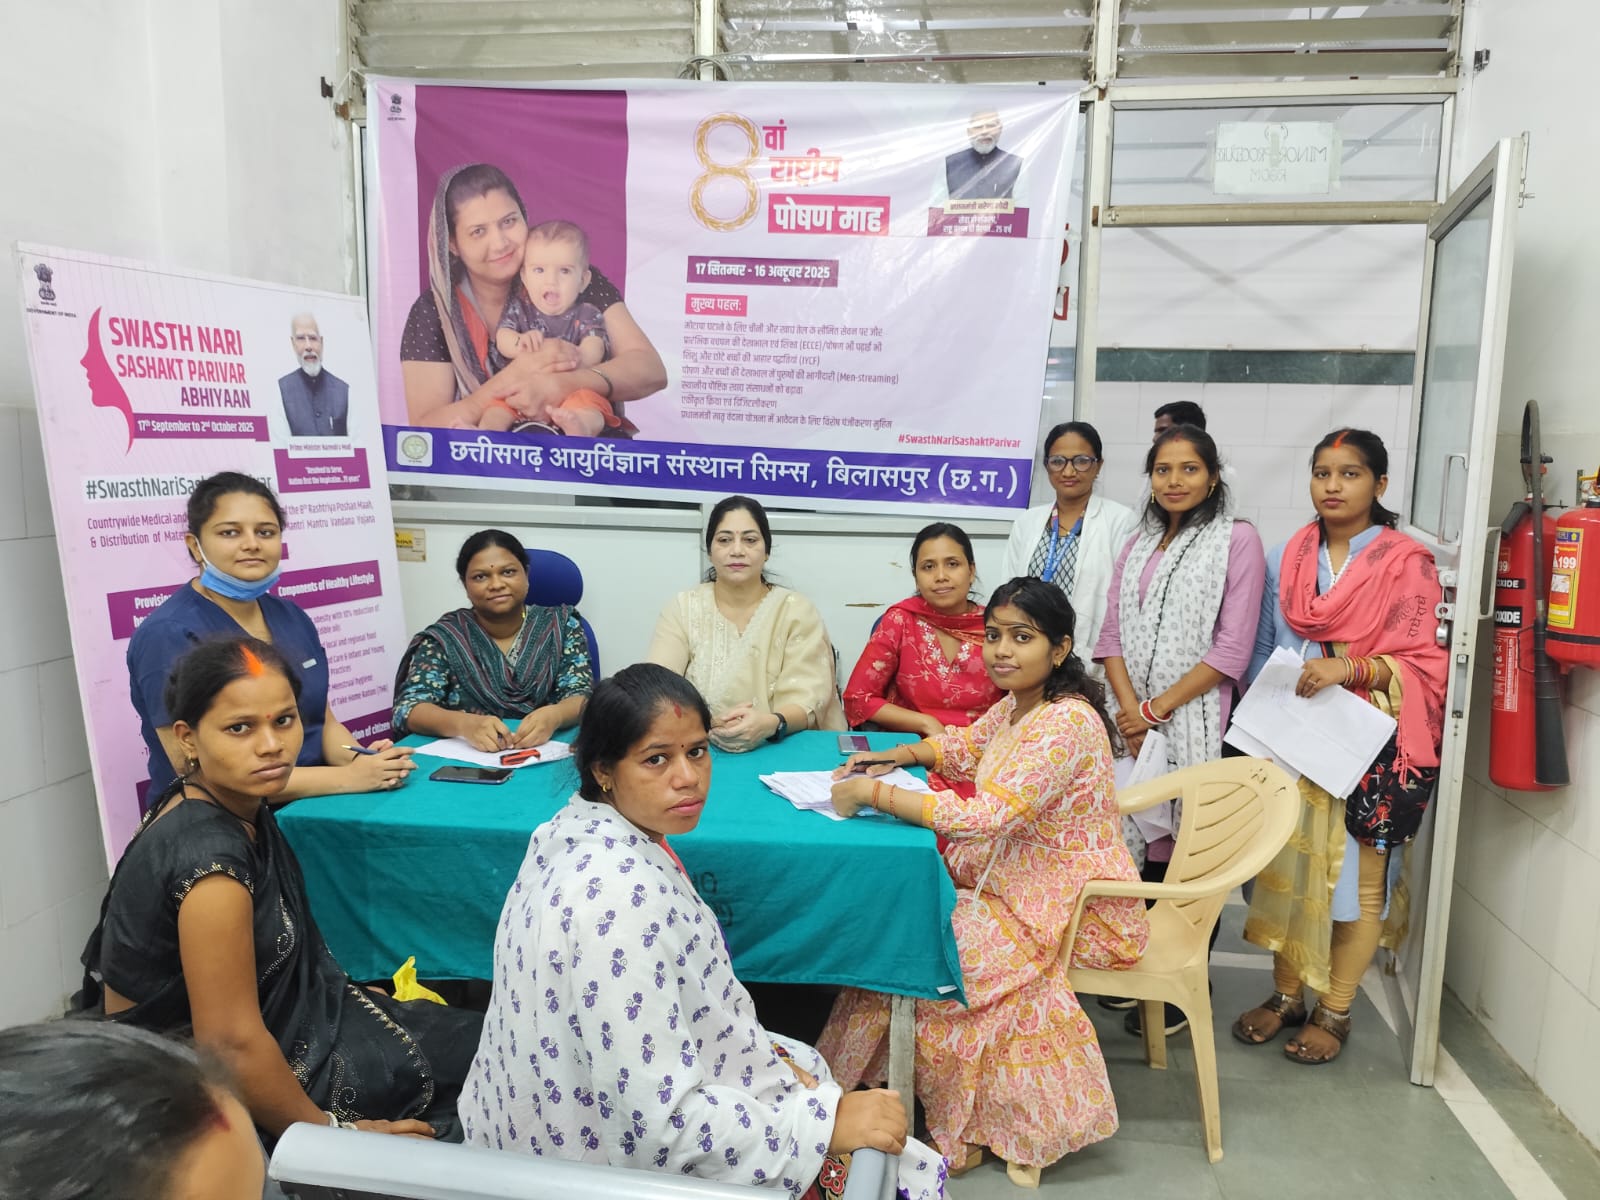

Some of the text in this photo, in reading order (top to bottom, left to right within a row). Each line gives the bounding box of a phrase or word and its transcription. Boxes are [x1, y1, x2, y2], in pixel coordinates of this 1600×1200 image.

[763, 119, 787, 151] वां
[774, 197, 884, 232] पोषण माह
[696, 263, 705, 275] 17
[708, 260, 746, 276] सितम्बर
[754, 265, 765, 277] 16
[768, 265, 803, 282] अक्टूबर
[804, 266, 830, 279] 2025
[691, 297, 715, 312] मुख्य
[108, 317, 243, 356] SWASTH NARI
[116, 354, 246, 384] SASHAKT PARIVAR
[836, 371, 899, 385] (Men-streaming)
[180, 386, 251, 409] ABHIYAAN
[151, 420, 192, 434] September
[192, 422, 201, 432] to
[211, 422, 238, 433] October
[238, 422, 254, 433] 2025
[898, 434, 1021, 448] #SwasthNariSashaktParivar
[449, 435, 1019, 500] छत्तीसगढ़ आयुर्विज्ञान संस्थान सिम्स, बिलासपुर (छ.ग.)
[88, 513, 187, 529] Countrywide Medical and
[90, 532, 161, 548] & Distribution of
[278, 582, 318, 597] Components
[318, 579, 325, 591] of
[326, 577, 349, 588] Healthy
[365, 725, 371, 737] of
[372, 721, 391, 735] citizen
